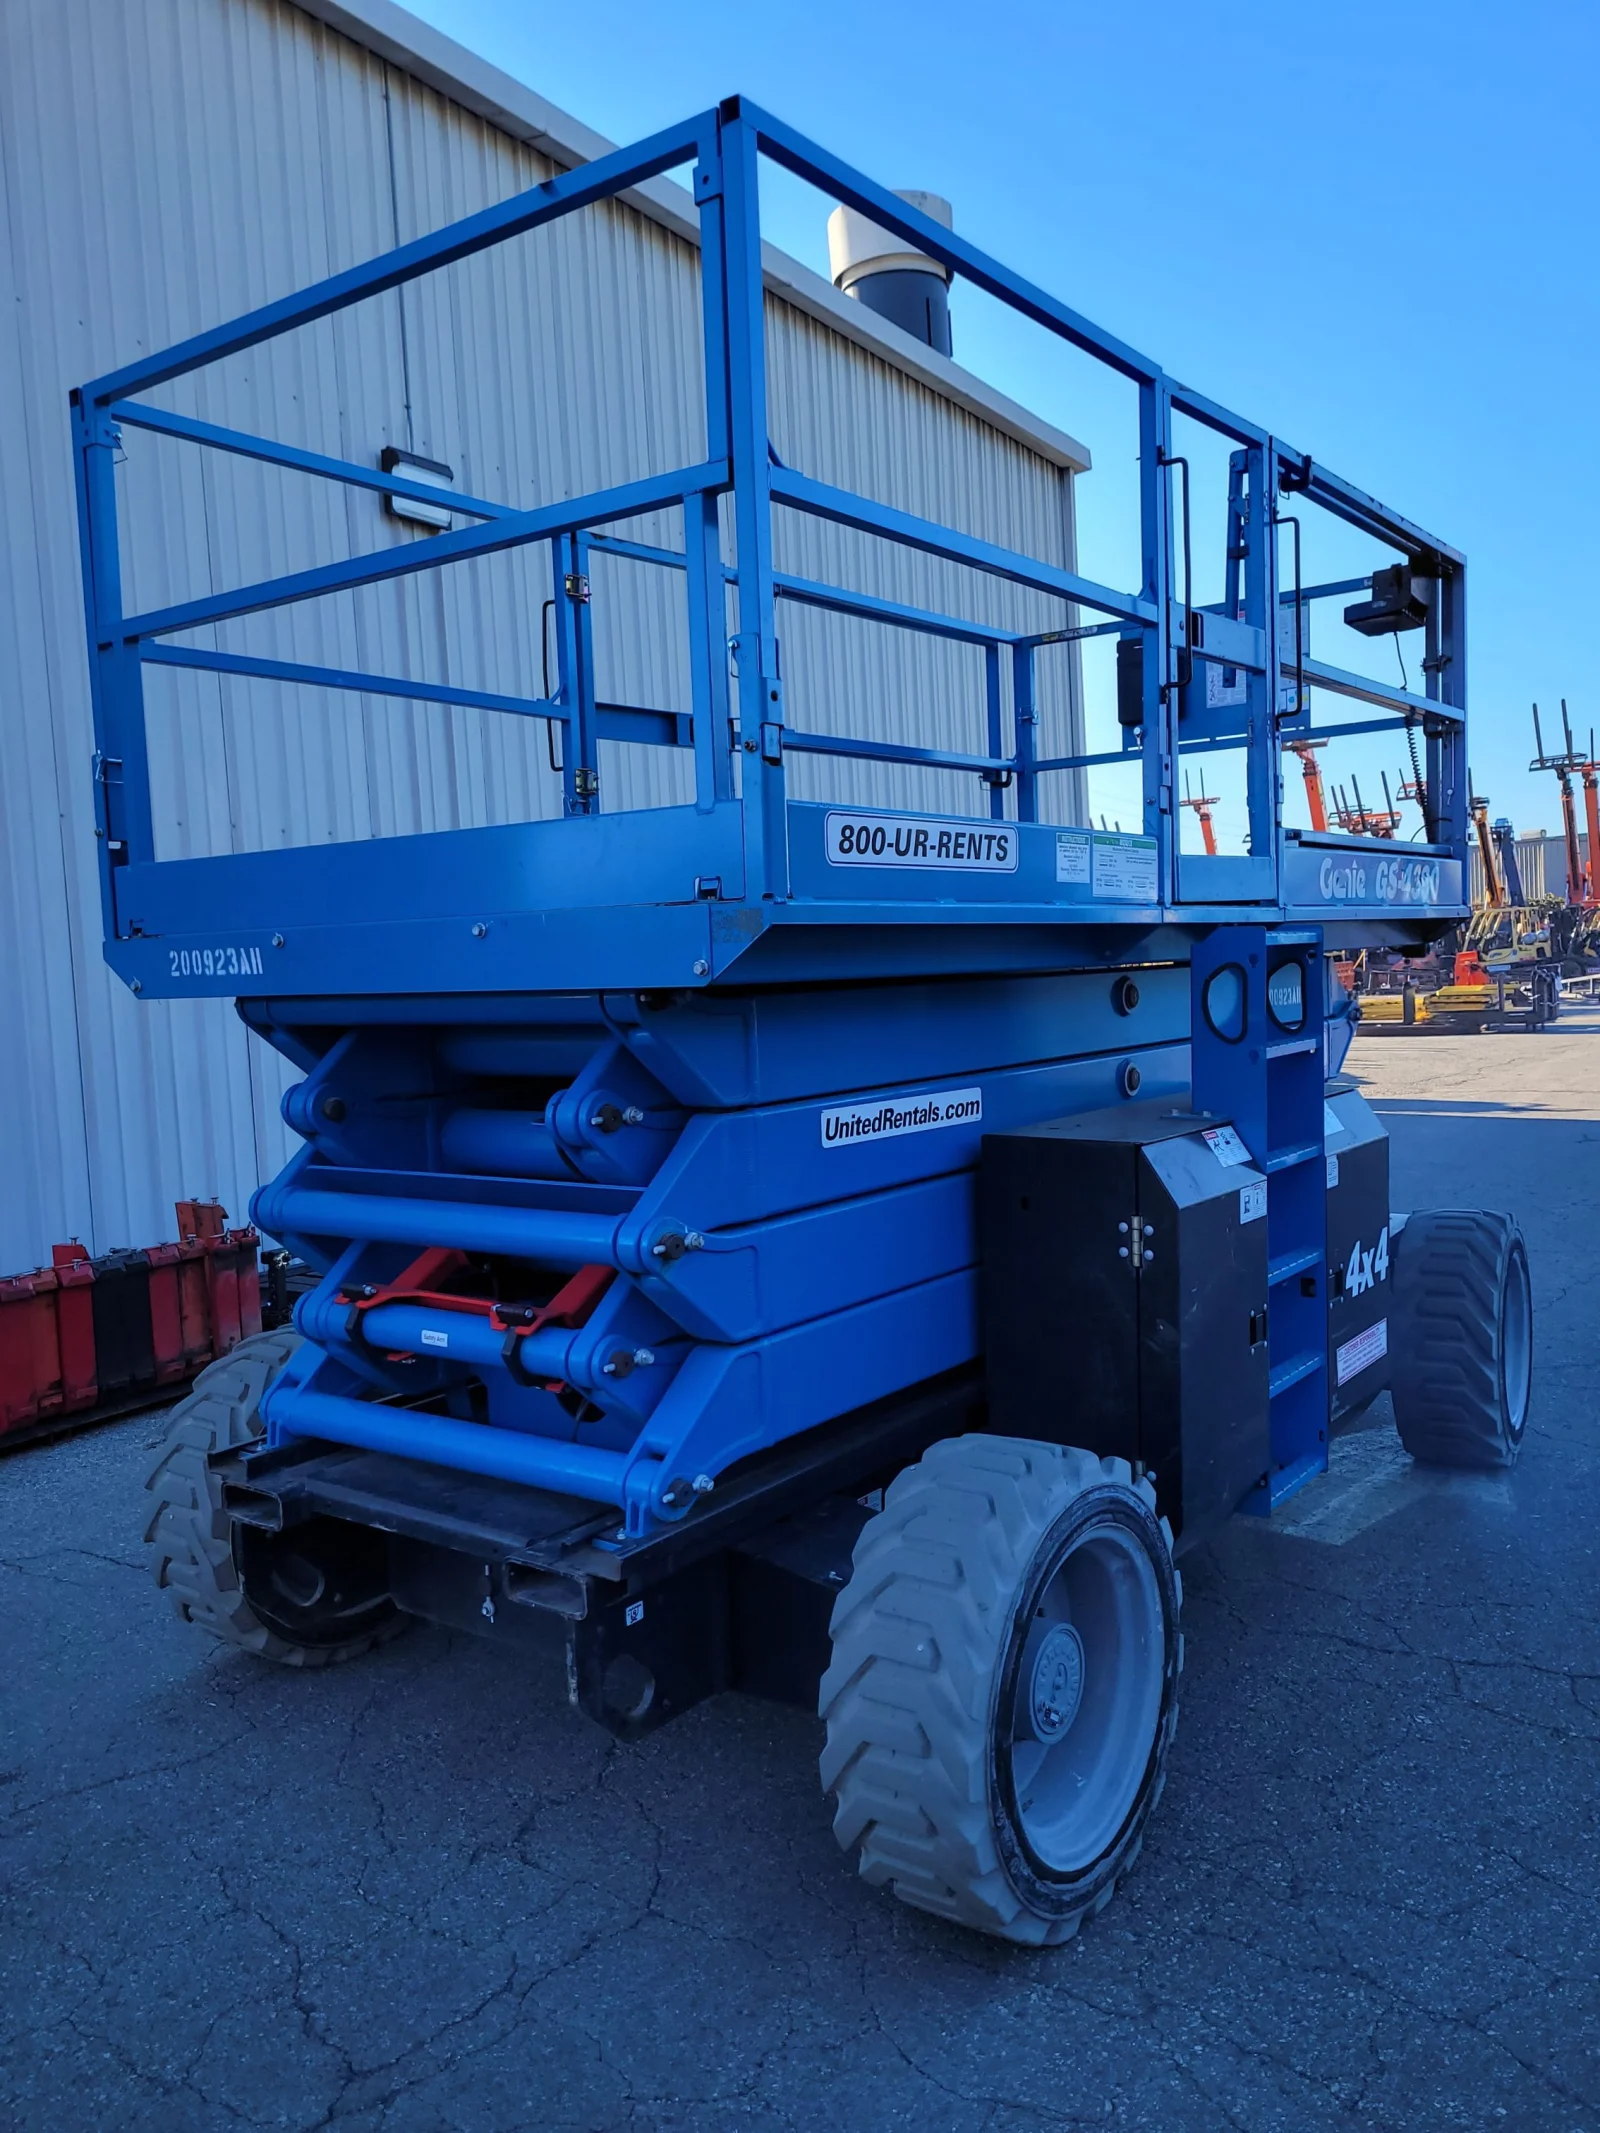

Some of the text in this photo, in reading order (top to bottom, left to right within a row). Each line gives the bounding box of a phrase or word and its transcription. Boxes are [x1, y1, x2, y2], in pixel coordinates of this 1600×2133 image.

[838, 824, 1009, 862] 800-UR-RENTS
[1319, 857, 1366, 900] Genie
[825, 1099, 980, 1141] UnitedRentals.com
[1345, 1227, 1389, 1298] 4x4
